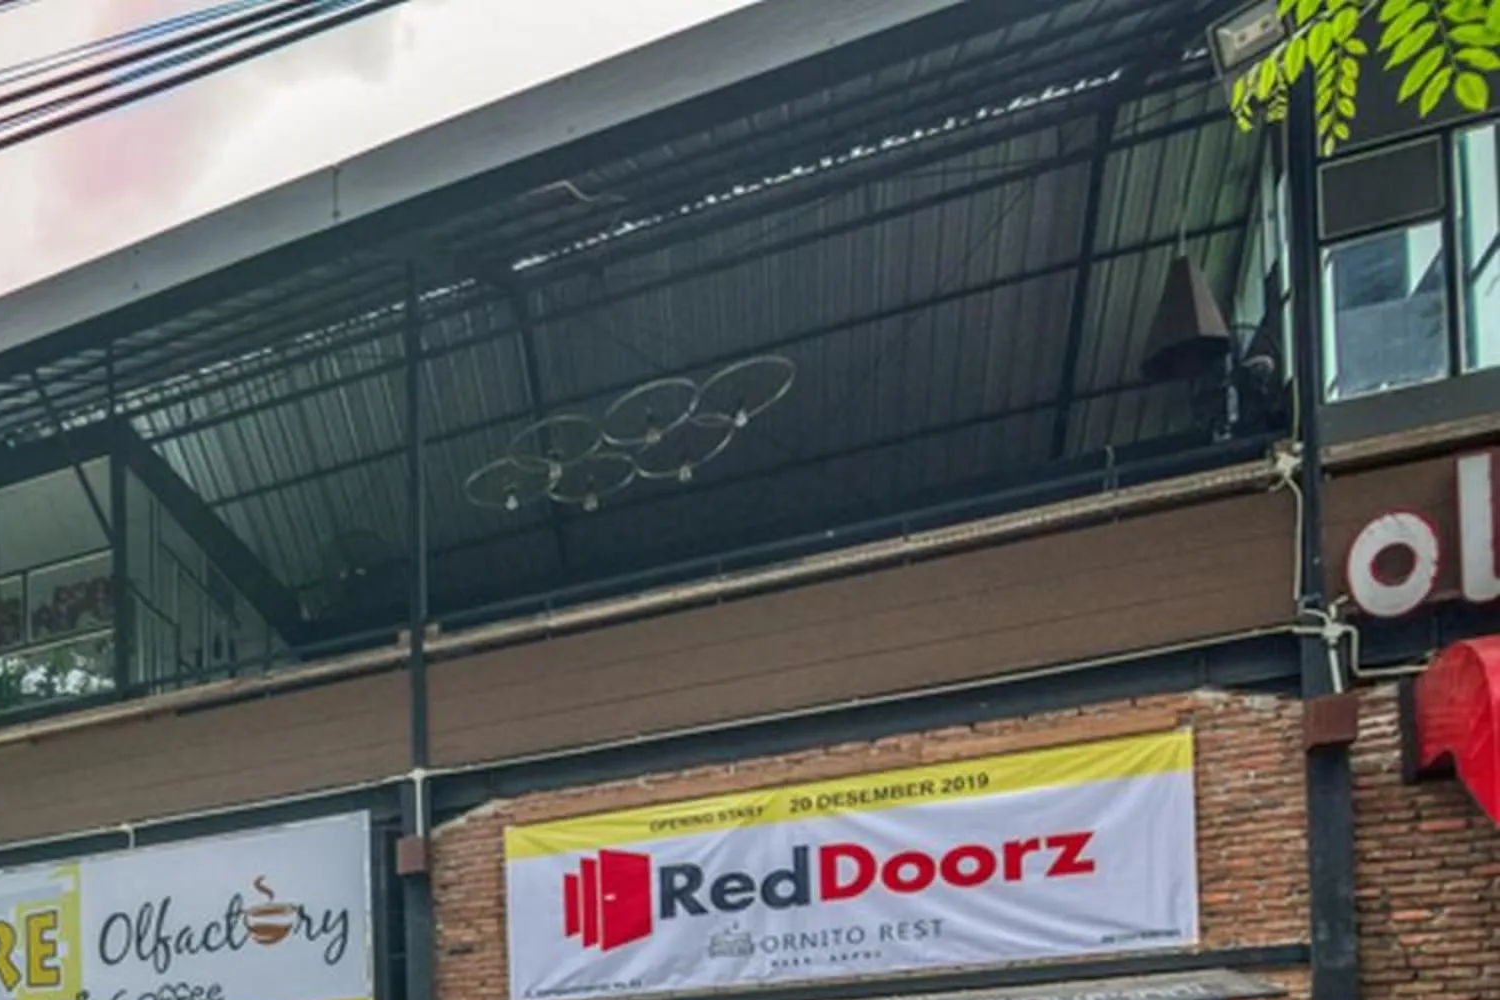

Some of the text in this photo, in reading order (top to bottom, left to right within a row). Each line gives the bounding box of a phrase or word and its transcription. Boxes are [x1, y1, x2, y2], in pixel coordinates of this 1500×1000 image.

[1347, 450, 1500, 618] ol
[816, 782, 936, 811] DESEMBER
[940, 771, 991, 793] 2019
[657, 831, 1096, 919] RedDoorz
[878, 918, 945, 942] REST
